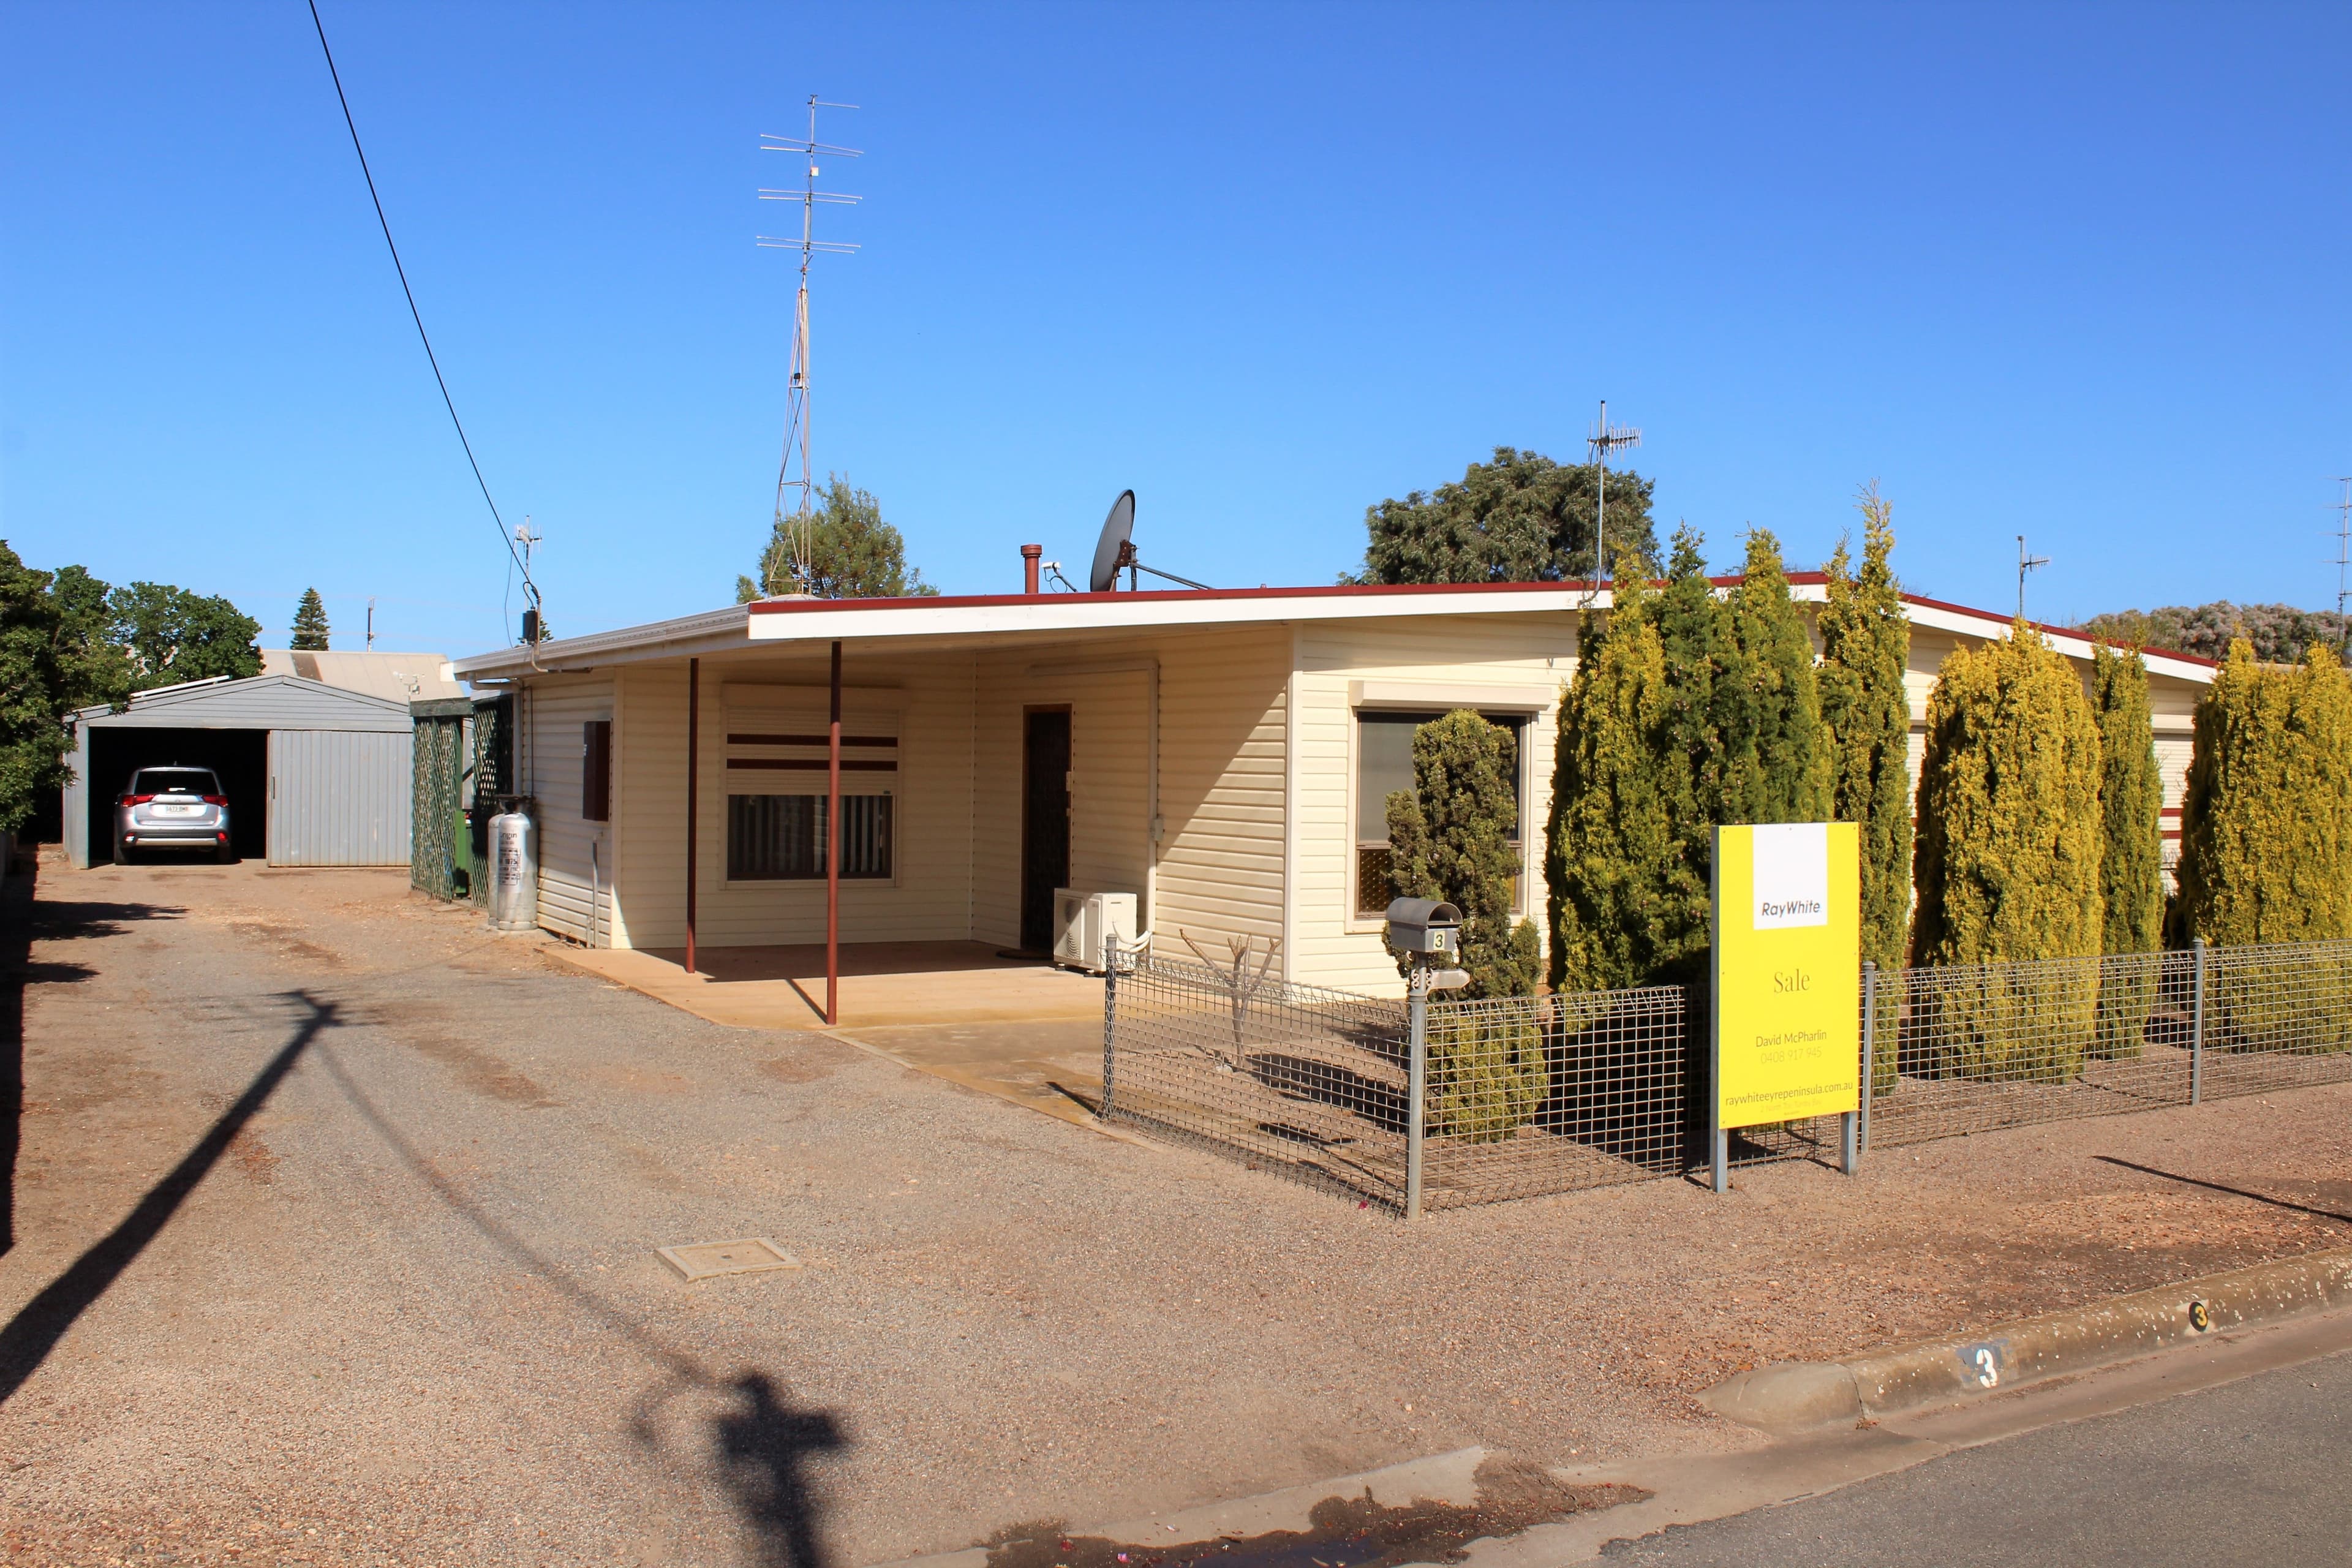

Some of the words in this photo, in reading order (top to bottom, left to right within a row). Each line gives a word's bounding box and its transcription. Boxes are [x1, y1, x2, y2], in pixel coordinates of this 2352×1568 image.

[1435, 934, 1443, 948] 3
[1774, 968, 1810, 993] Sale
[1755, 1034, 1781, 1047] David
[1784, 1029, 1827, 1044] McPharlin
[1760, 1050, 1785, 1064] 0408
[1787, 1048, 1804, 1061] 917
[1806, 1046, 1822, 1058] 945
[1725, 1081, 1853, 1106] raywhiteeyrepeninsula.com.au
[2195, 1305, 2207, 1327] 3
[1975, 1348, 1998, 1389] 3
